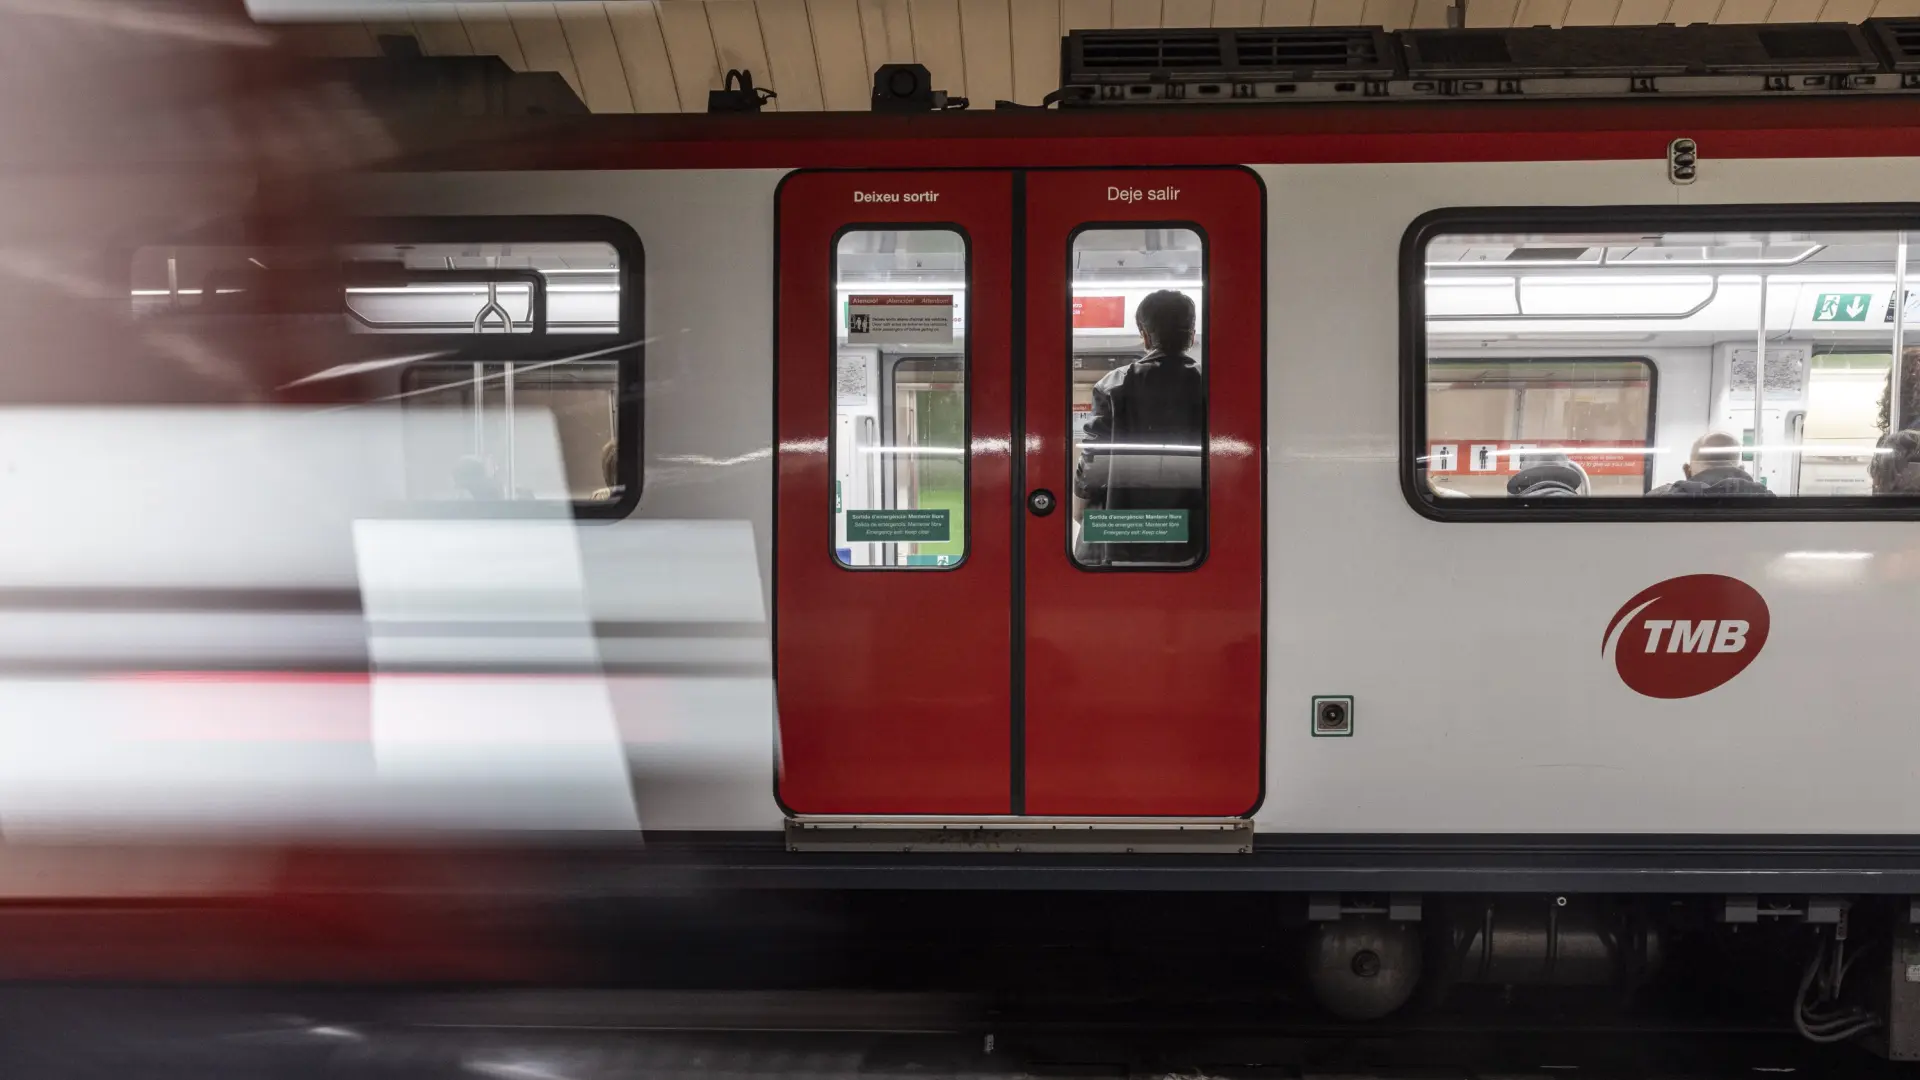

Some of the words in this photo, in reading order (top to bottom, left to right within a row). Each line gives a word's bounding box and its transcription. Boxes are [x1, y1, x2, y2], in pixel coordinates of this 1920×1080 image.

[854, 190, 900, 203] Deixeu
[903, 190, 939, 202] sortir
[1107, 186, 1143, 204] Deje
[1147, 186, 1180, 201] salir
[1643, 619, 1750, 654] TMB
